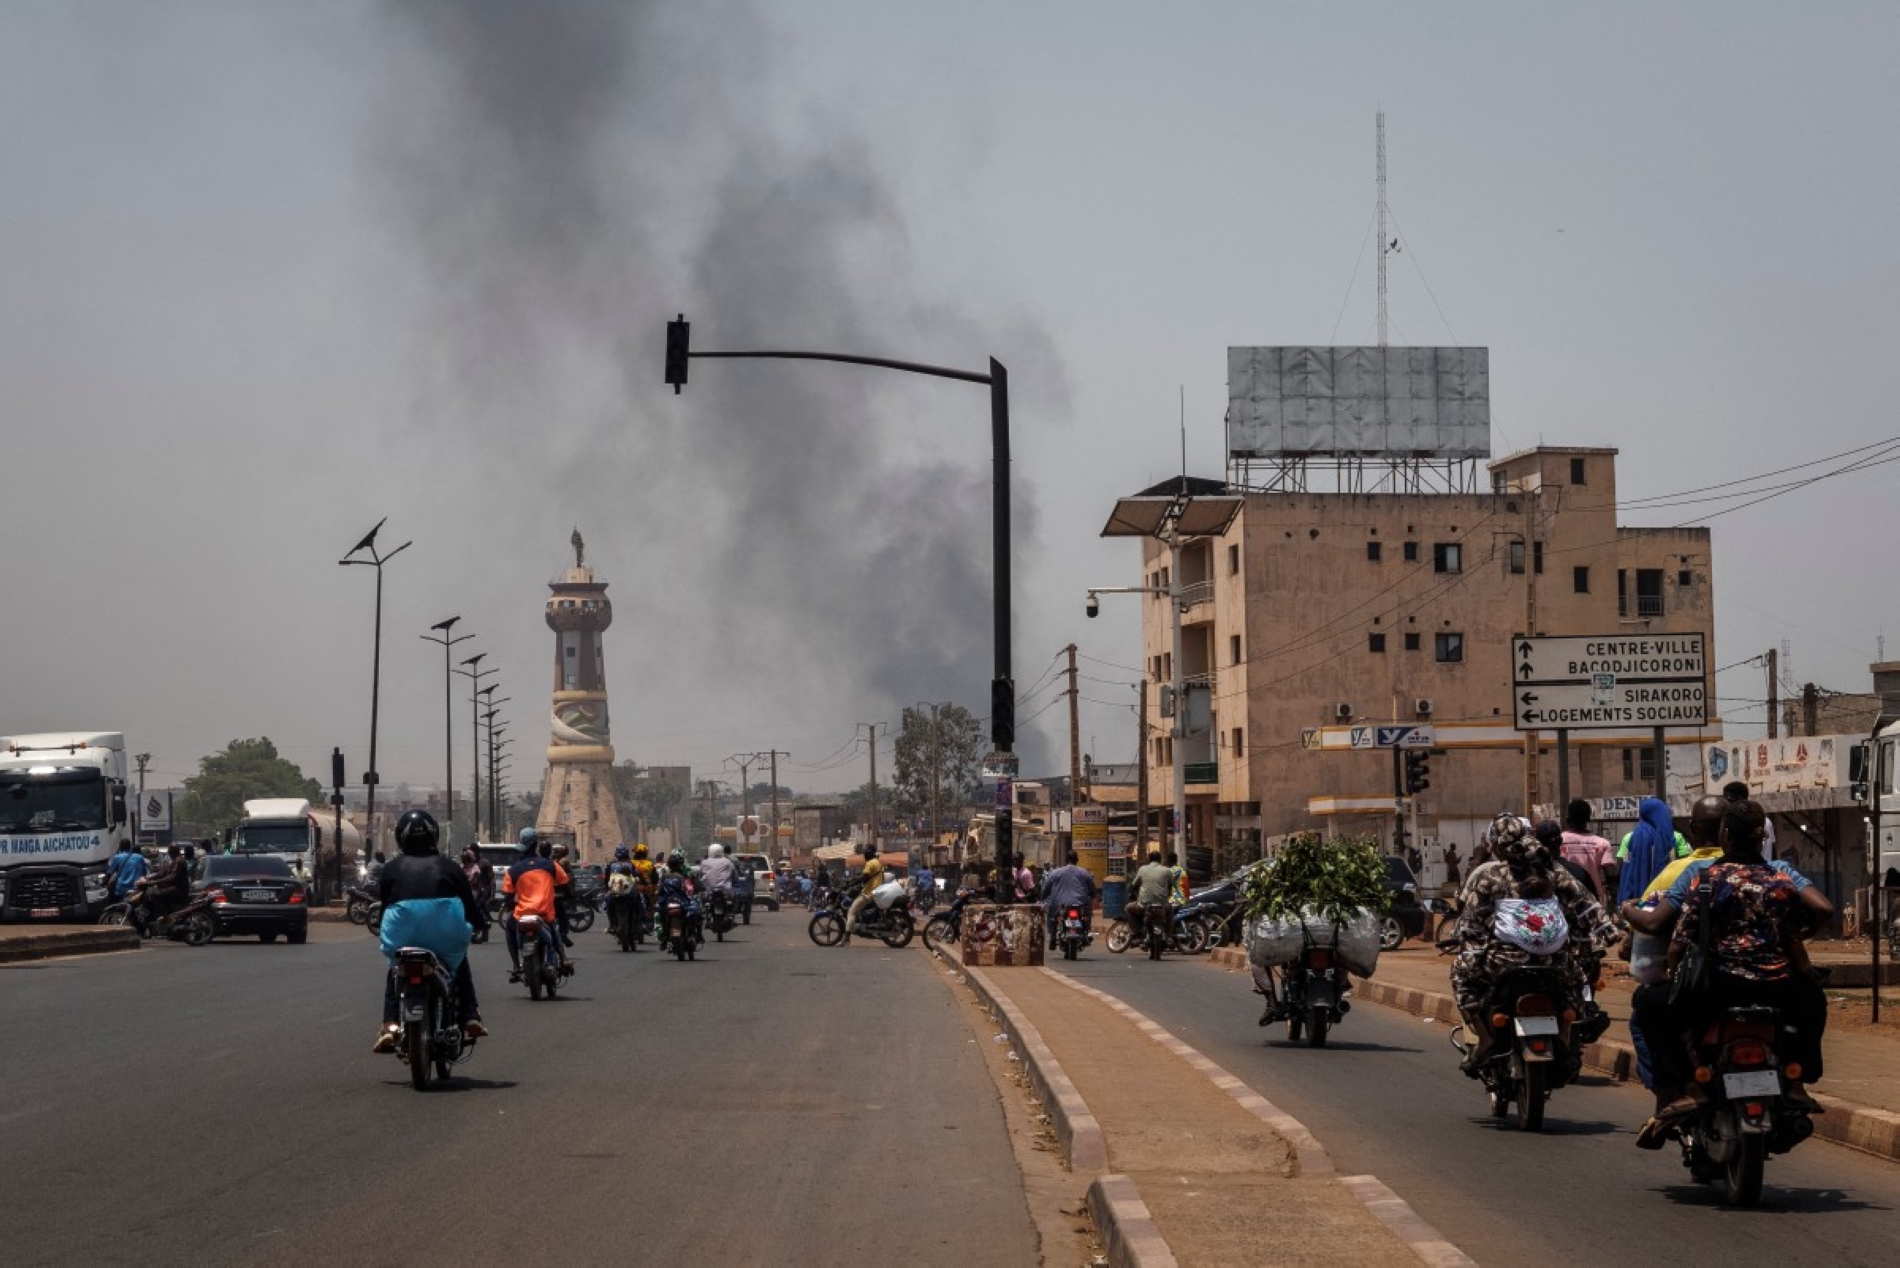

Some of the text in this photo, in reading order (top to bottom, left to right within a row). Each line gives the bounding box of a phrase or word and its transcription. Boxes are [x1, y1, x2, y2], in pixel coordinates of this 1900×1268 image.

[1586, 641, 1700, 656] CENTRE-VILLE
[1569, 658, 1701, 674] BACODJICORONI
[1625, 688, 1703, 702] SIRAKORO
[1540, 706, 1703, 722] LOGEMENTS SOCIAUX
[11, 838, 41, 854] MAIGA
[43, 835, 90, 852] AICHATOU
[90, 835, 100, 846] 4
